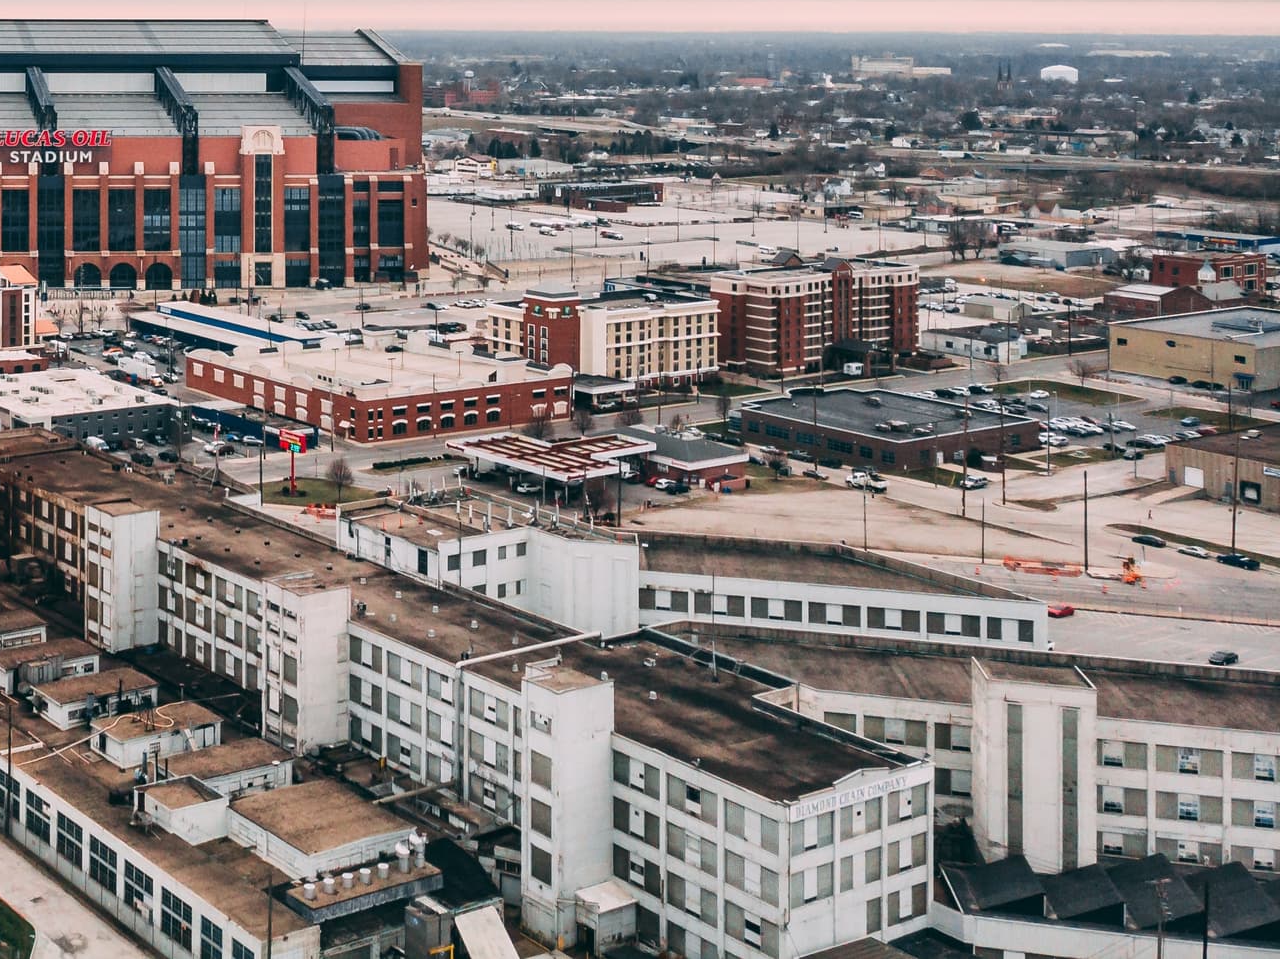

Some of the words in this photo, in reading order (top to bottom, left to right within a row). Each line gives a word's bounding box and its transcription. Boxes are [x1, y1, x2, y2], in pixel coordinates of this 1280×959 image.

[71, 129, 112, 147] OIL
[10, 150, 93, 164] STADIUM
[795, 797, 837, 818] DIAMOND
[839, 788, 865, 805] CHAIN
[867, 777, 908, 797] COMPANY
